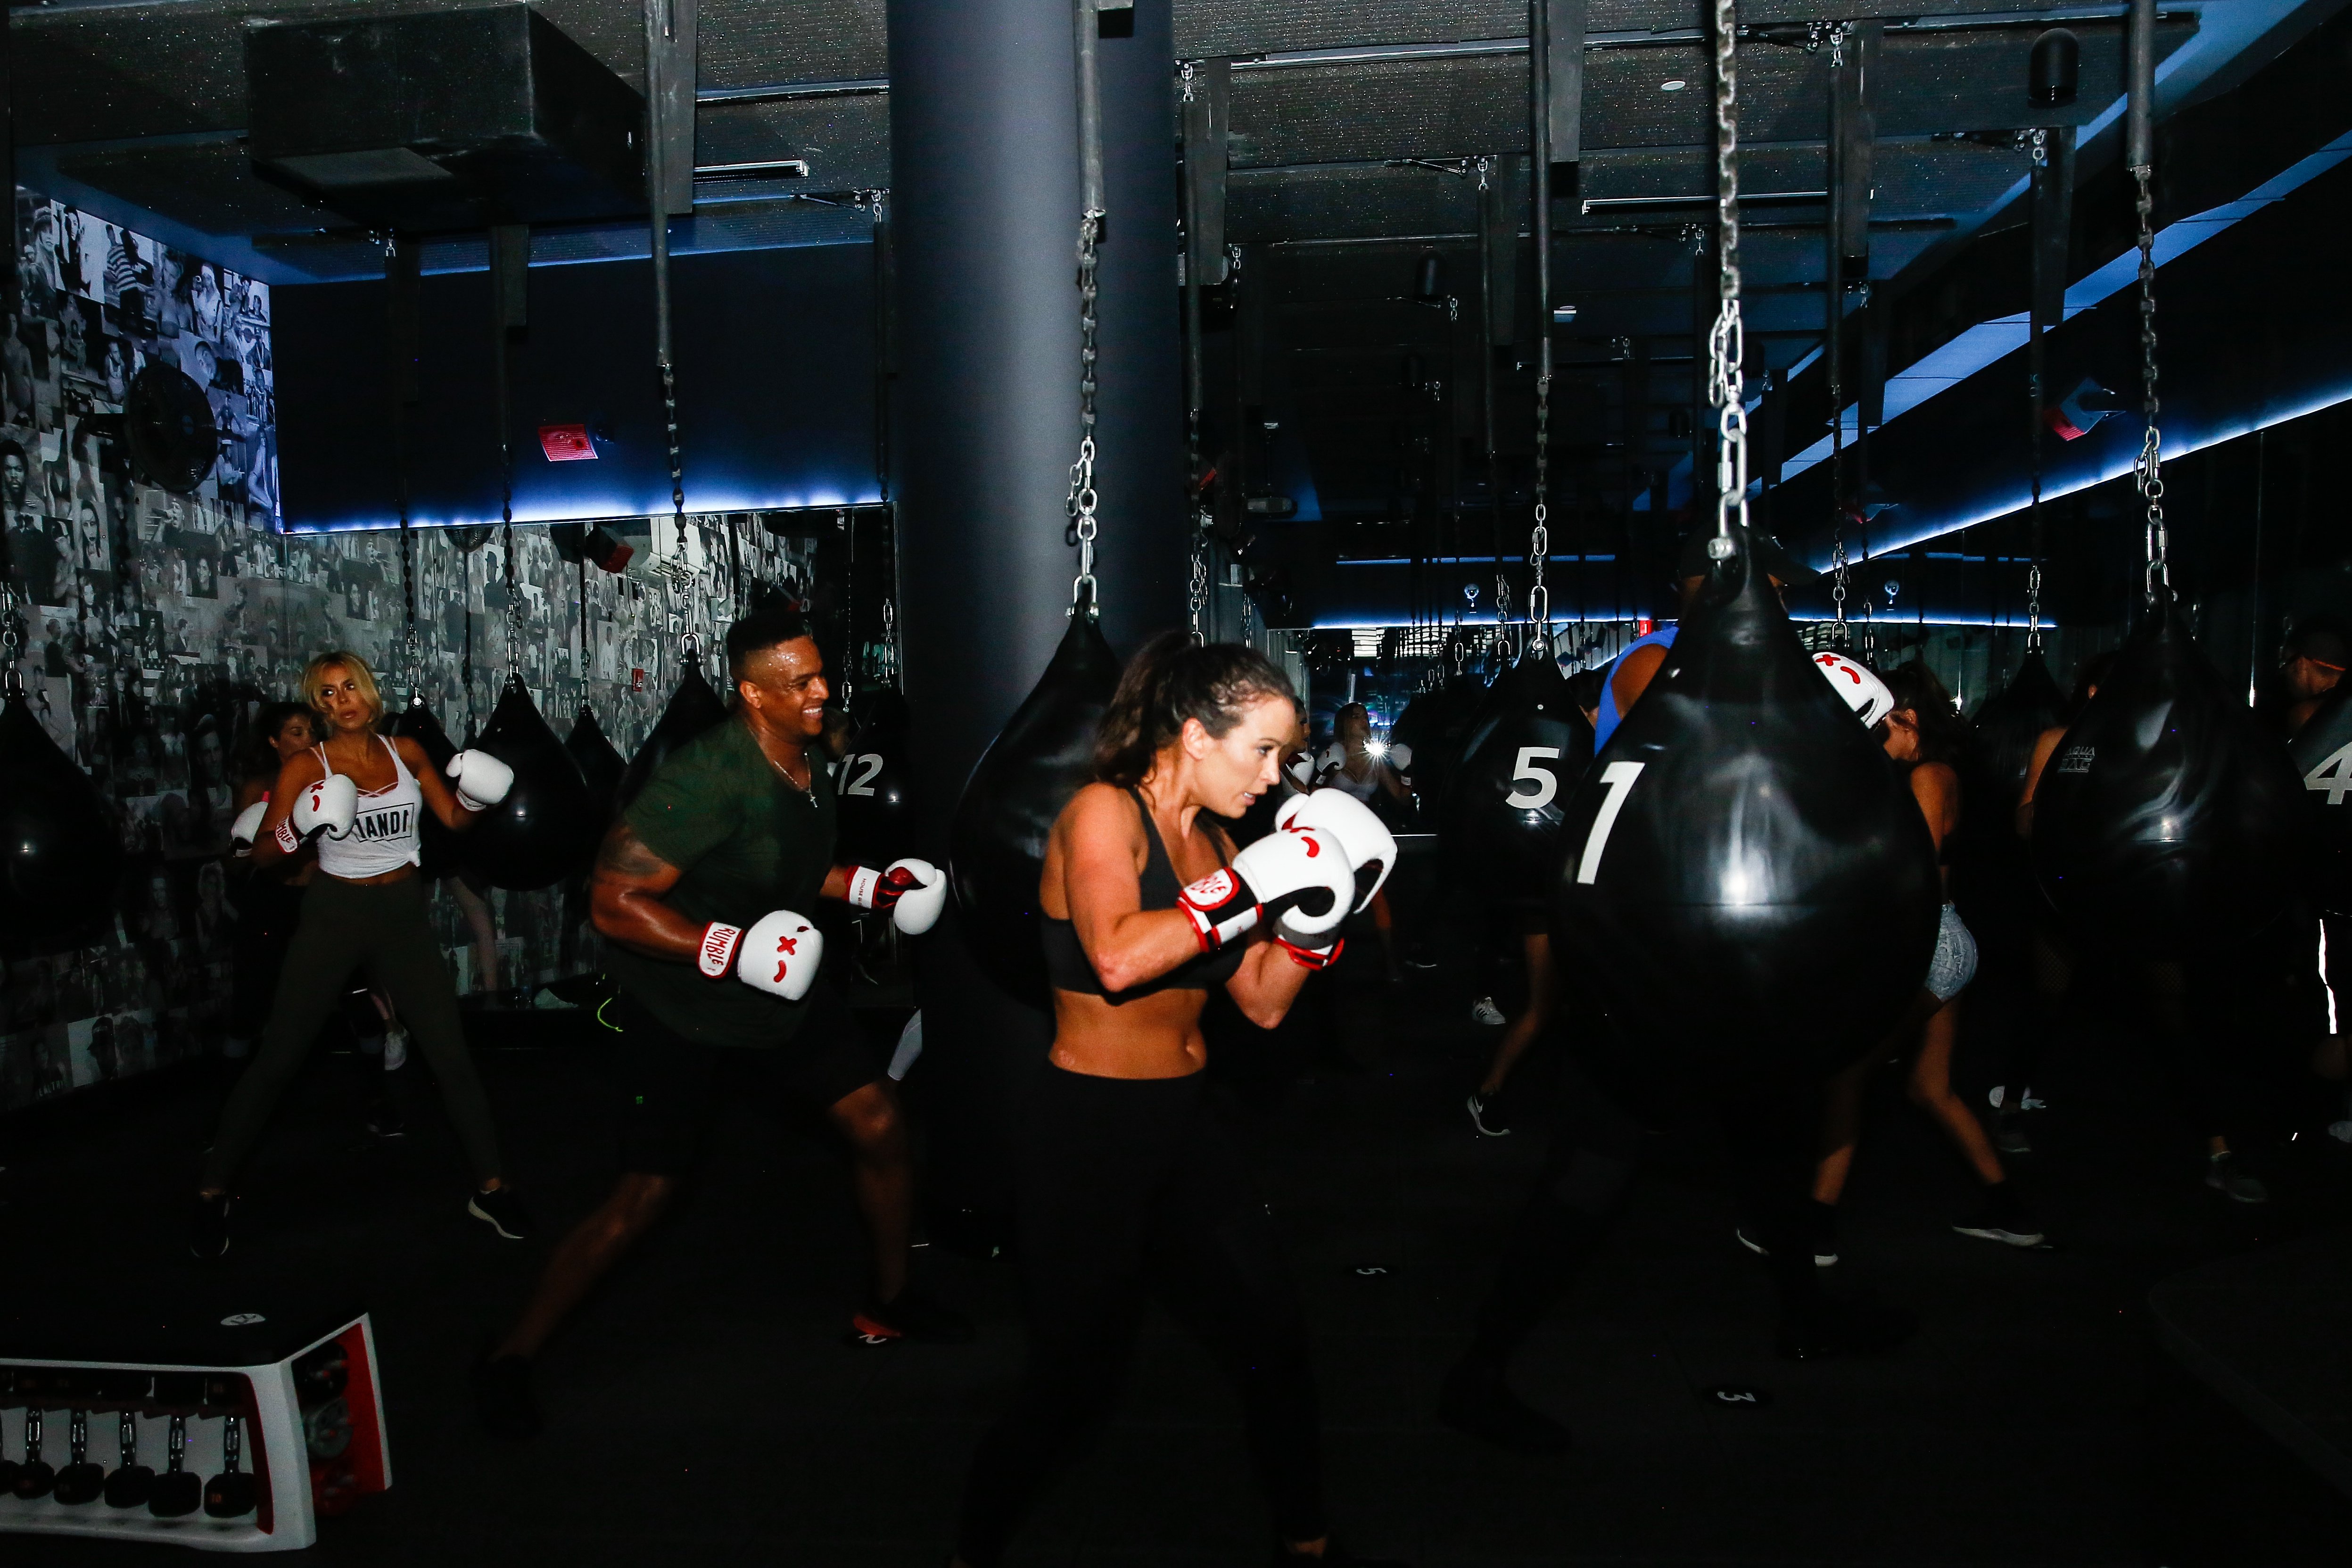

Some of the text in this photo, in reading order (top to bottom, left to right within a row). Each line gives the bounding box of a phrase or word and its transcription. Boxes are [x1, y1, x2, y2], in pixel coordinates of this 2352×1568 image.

[837, 753, 883, 797] 12
[1506, 747, 1560, 809] 5
[2303, 741, 2352, 804] 4
[1577, 761, 1646, 884] 1
[706, 927, 736, 966] RUMBLE
[1356, 1267, 1387, 1275] 5
[1717, 1389, 1756, 1403] 3
